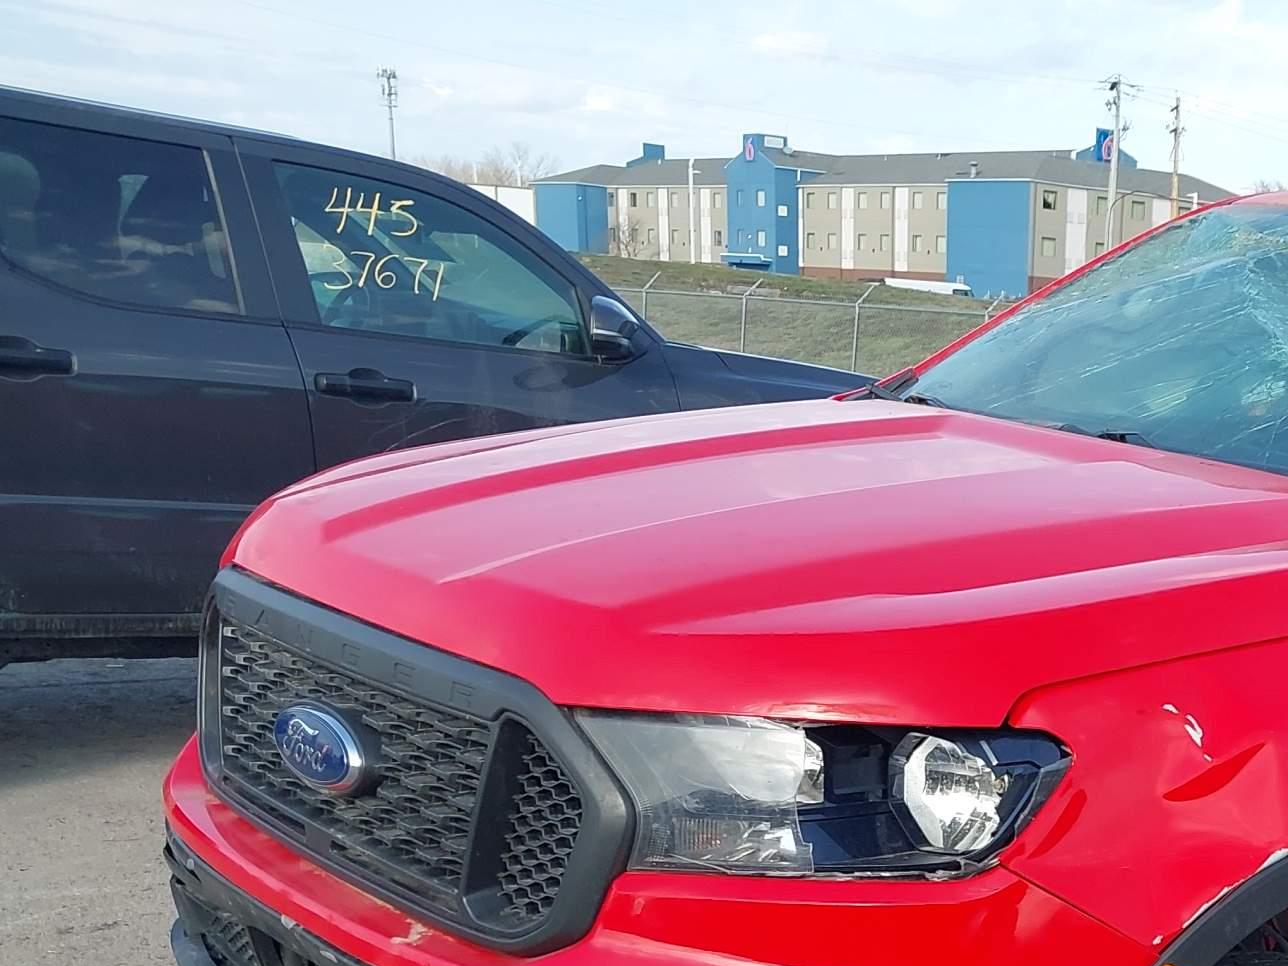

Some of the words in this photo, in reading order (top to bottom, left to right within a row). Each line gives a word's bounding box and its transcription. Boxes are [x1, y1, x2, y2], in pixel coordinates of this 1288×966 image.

[744, 135, 755, 161] 6
[325, 187, 418, 236] 445
[324, 245, 444, 302] 37671
[222, 595, 475, 708] RANGER
[282, 718, 329, 772] Ford
